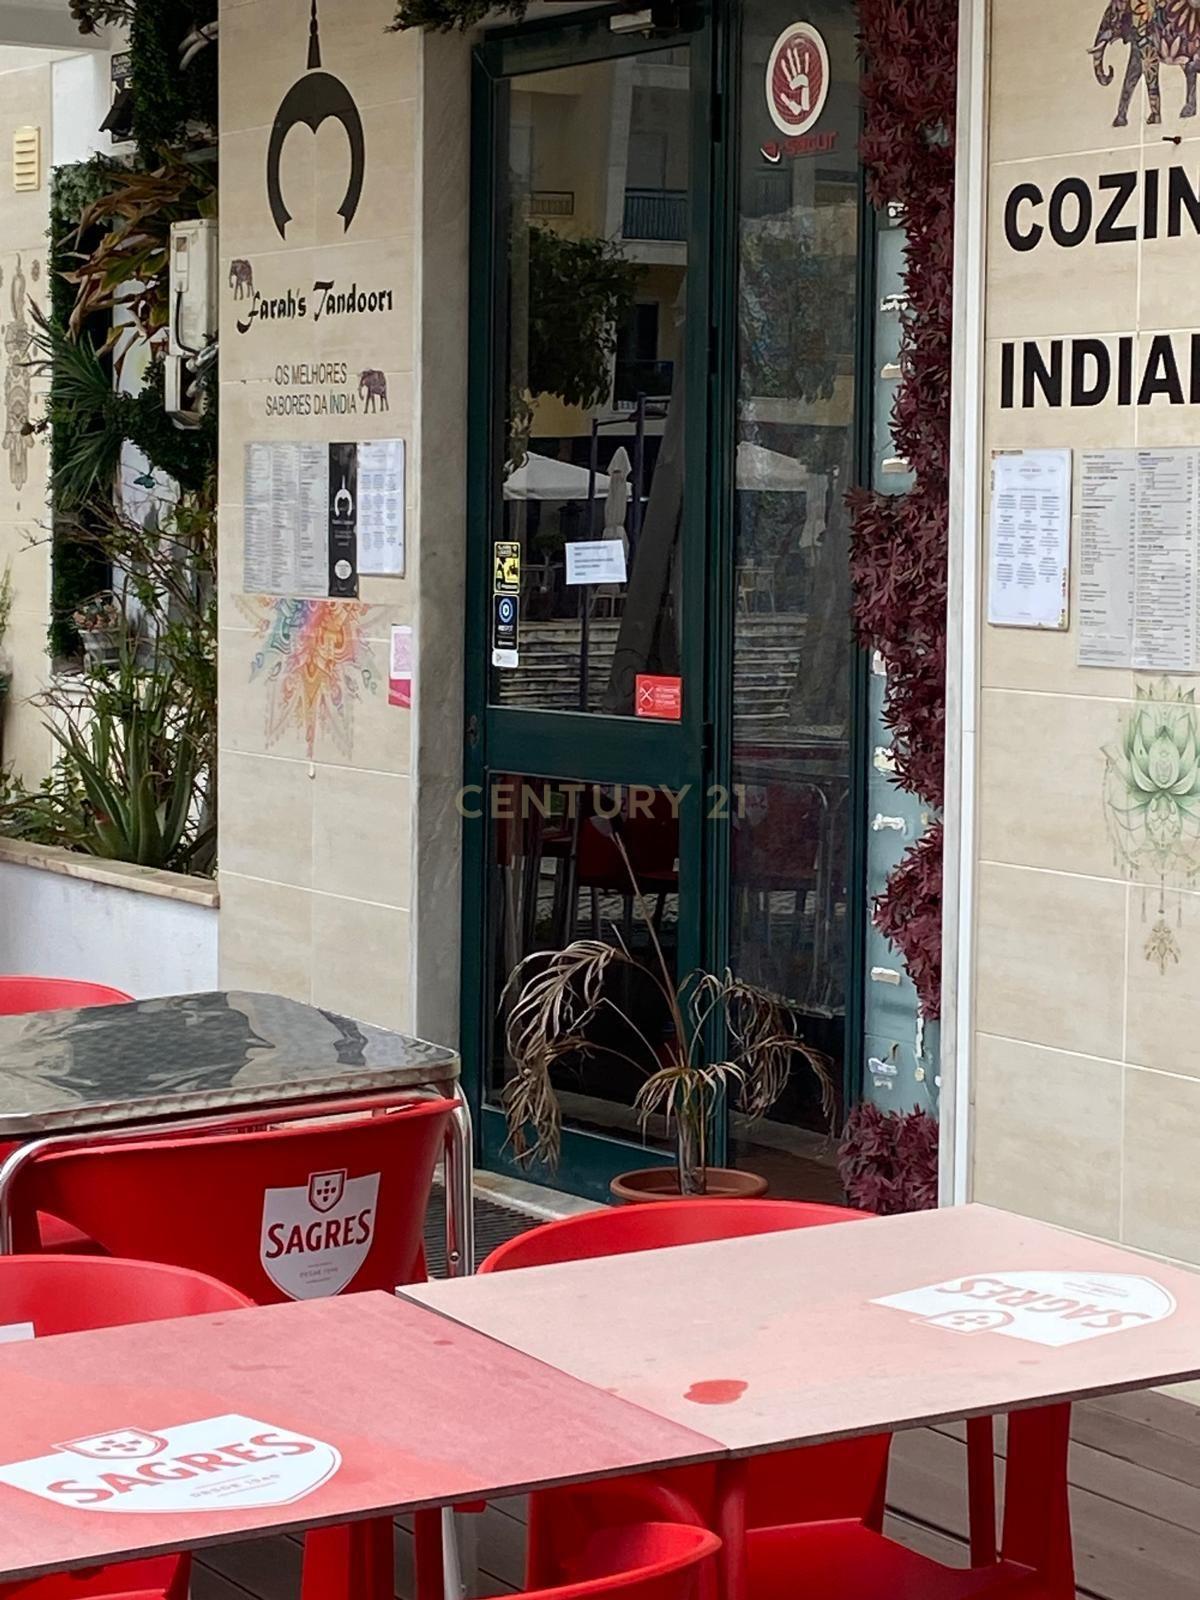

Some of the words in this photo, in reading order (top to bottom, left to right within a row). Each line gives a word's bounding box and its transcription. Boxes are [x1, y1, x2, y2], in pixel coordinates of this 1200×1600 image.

[274, 365, 289, 385] OS
[291, 363, 347, 384] MELHORES
[1000, 334, 1200, 409] INDIA
[265, 394, 311, 416] SABORES
[314, 393, 327, 414] DA
[329, 389, 357, 414] ÍNDIA
[265, 1208, 371, 1259] SAGRES
[936, 1278, 1152, 1328] SAGRES
[47, 1432, 316, 1504] SAGRES
